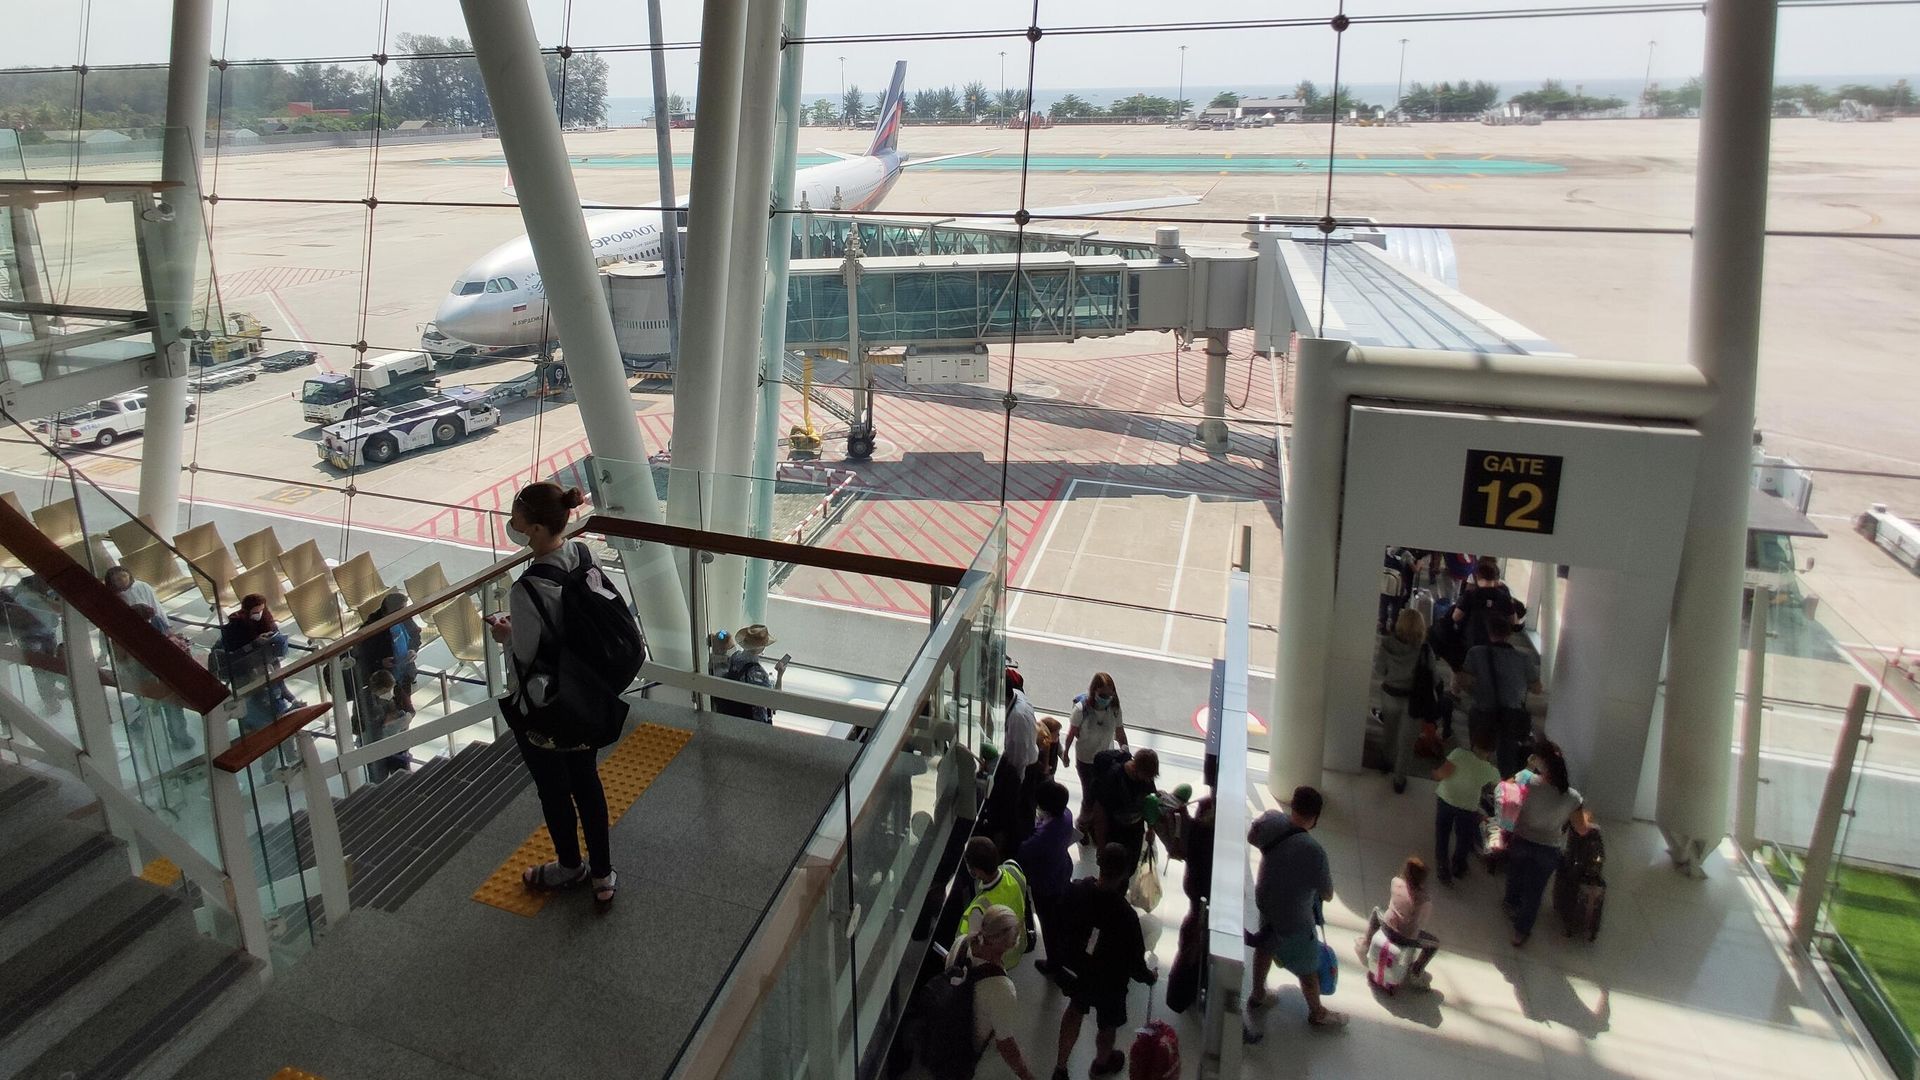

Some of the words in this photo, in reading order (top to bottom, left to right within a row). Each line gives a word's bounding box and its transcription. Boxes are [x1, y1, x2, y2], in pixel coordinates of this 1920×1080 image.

[590, 224, 657, 249] ЭРОФЛОТ
[1483, 455, 1544, 476] GATE
[1477, 479, 1543, 529] 12
